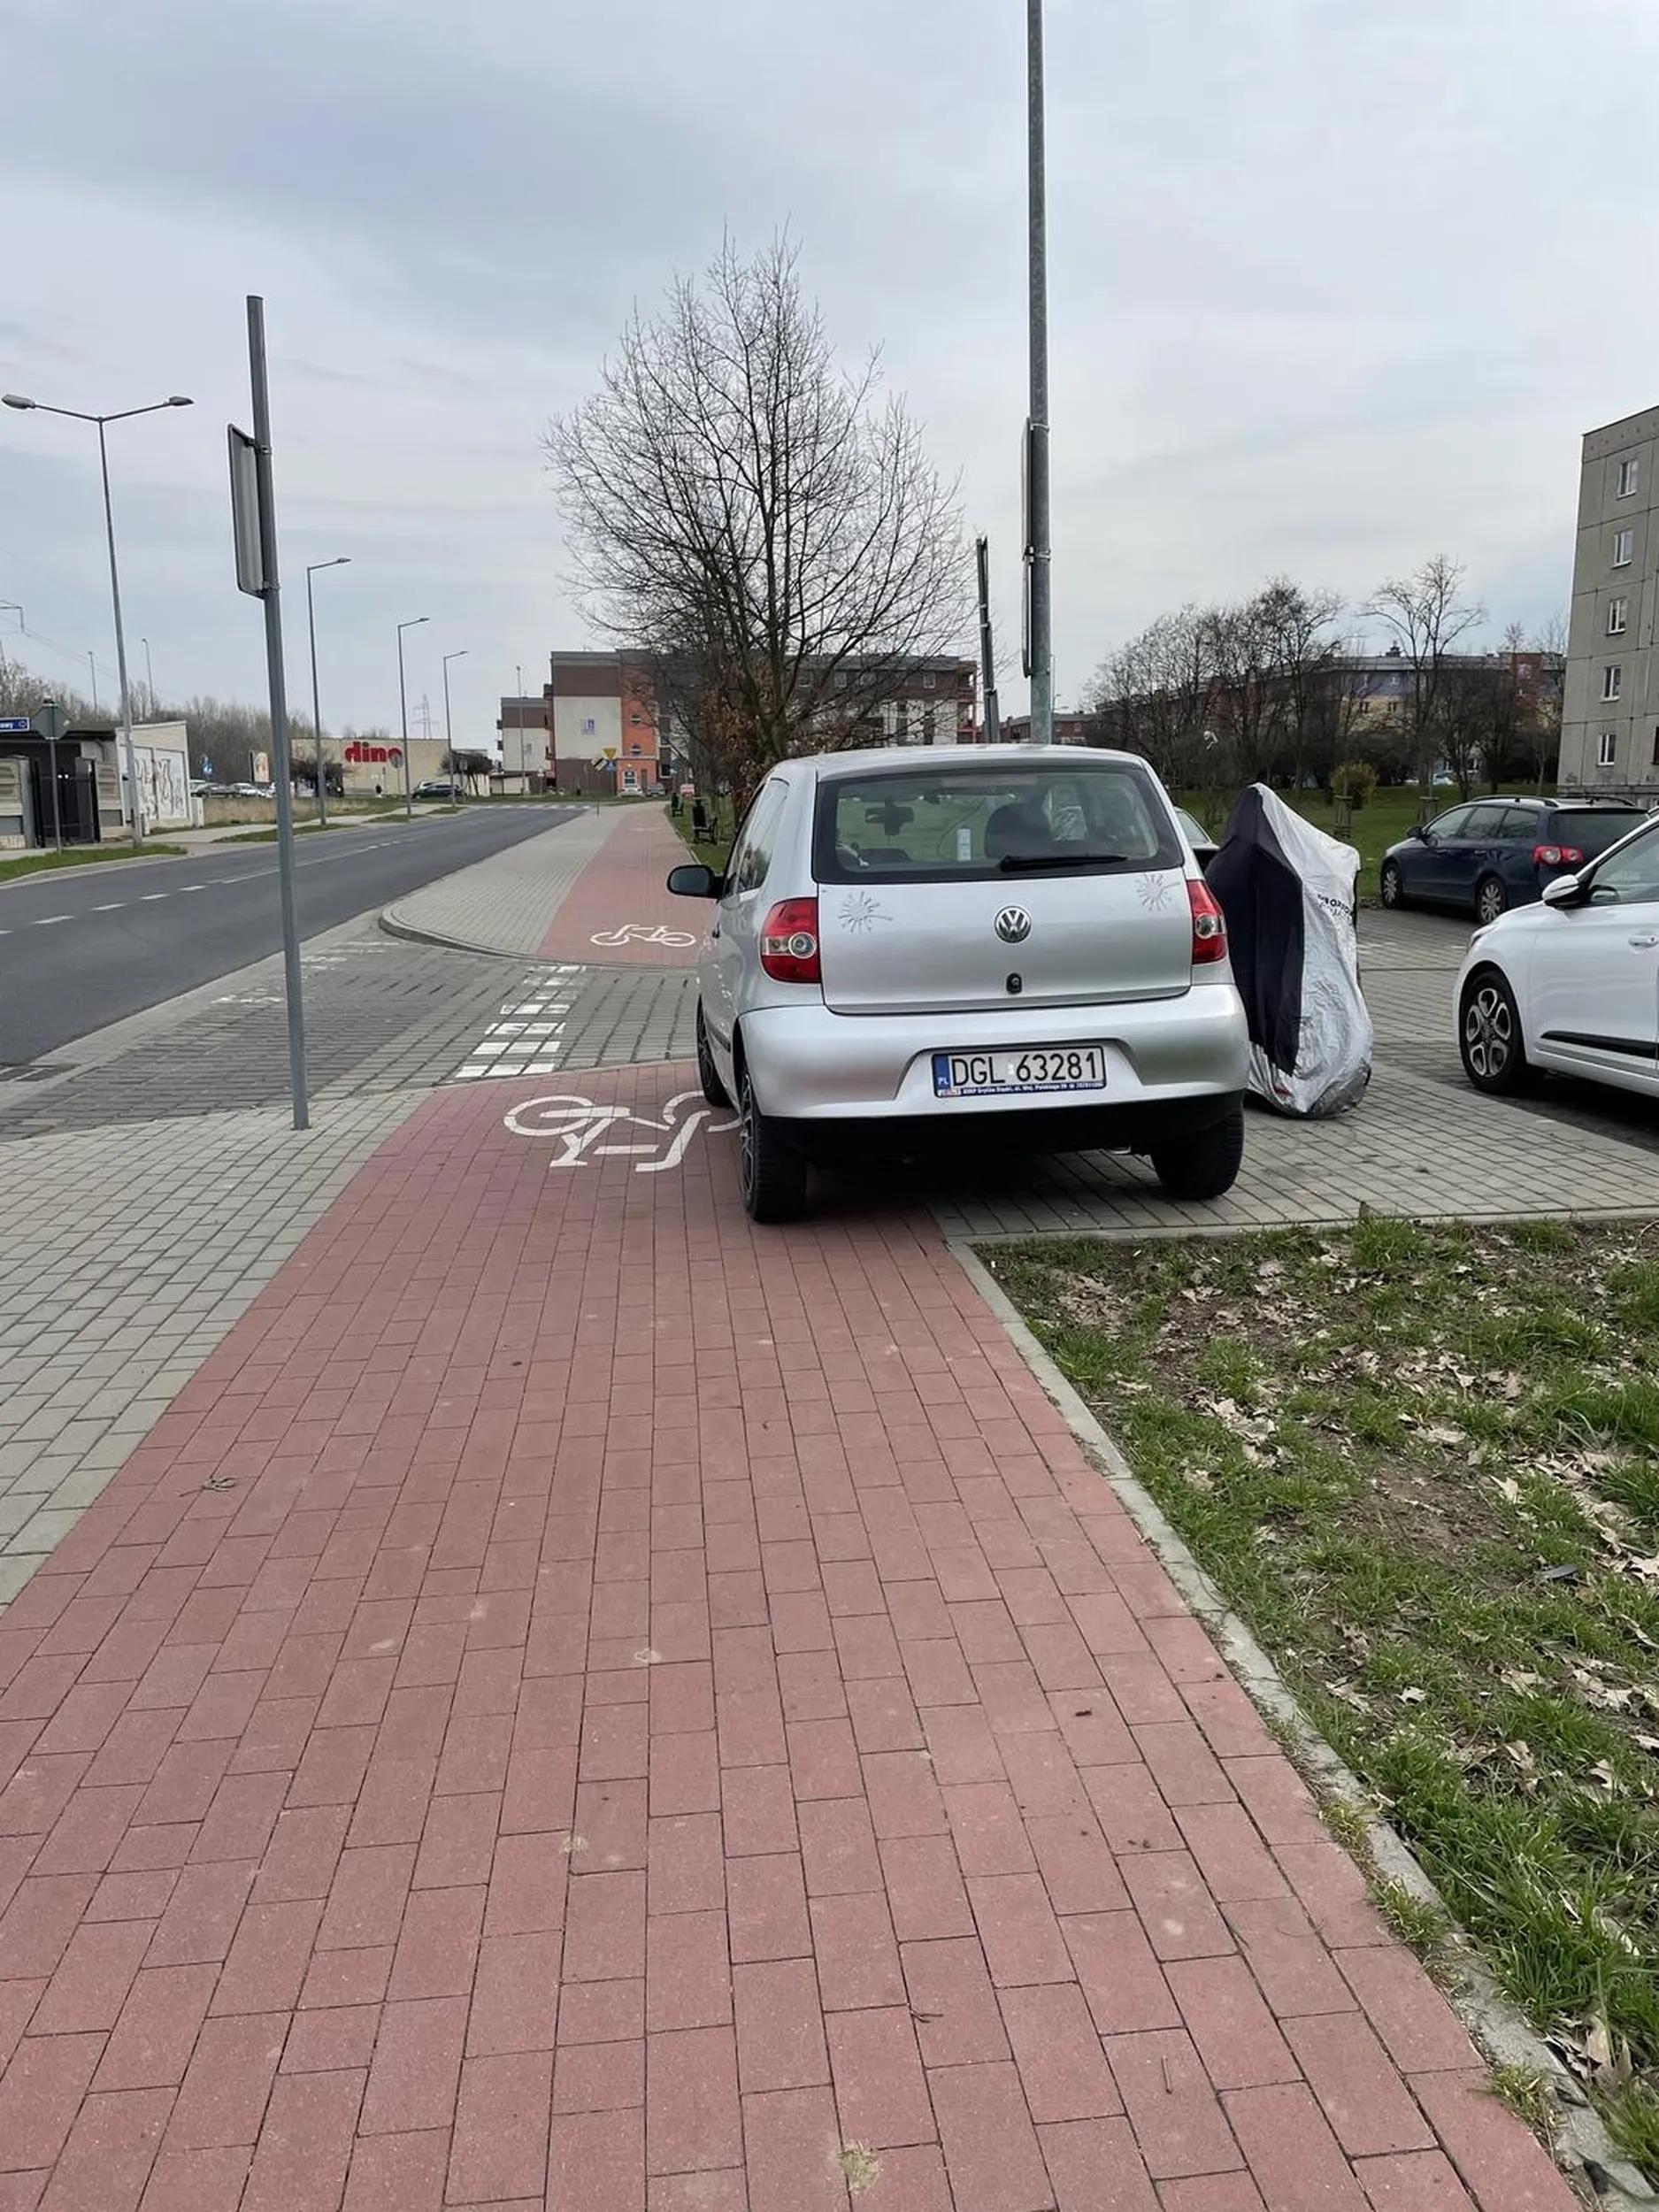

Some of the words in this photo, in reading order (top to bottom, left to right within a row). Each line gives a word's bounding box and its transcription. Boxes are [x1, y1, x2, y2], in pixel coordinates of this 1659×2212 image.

[345, 741, 403, 768] dino
[951, 1056, 1005, 1087] DGL
[1017, 1051, 1097, 1082] 63281
